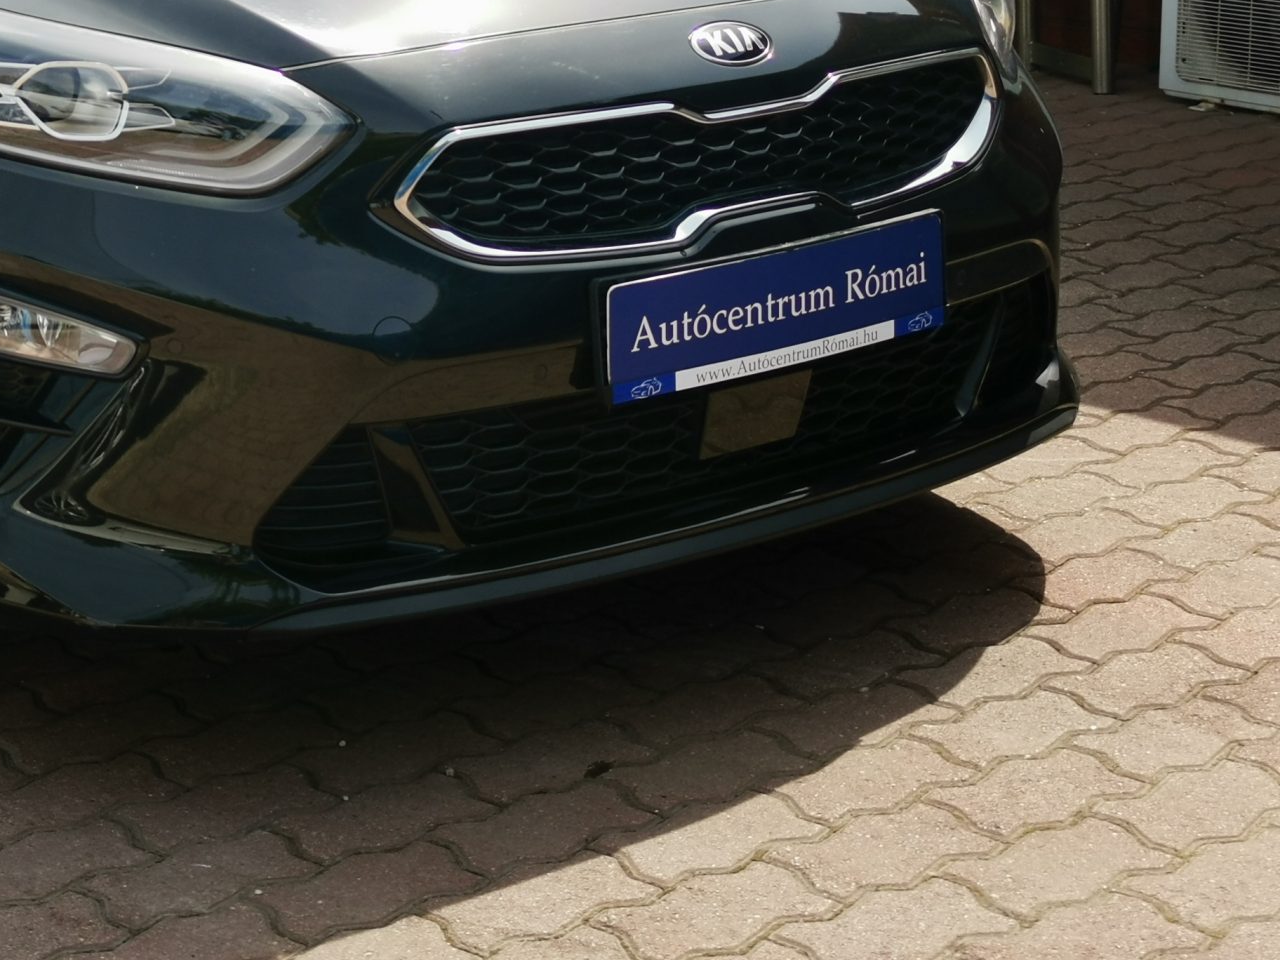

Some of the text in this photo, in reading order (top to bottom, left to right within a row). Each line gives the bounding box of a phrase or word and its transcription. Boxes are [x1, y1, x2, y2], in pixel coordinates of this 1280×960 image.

[703, 26, 765, 56] KIA
[631, 252, 928, 353] Autócentrum Római
[695, 328, 879, 385] www.AutócentrumRómai.hu
